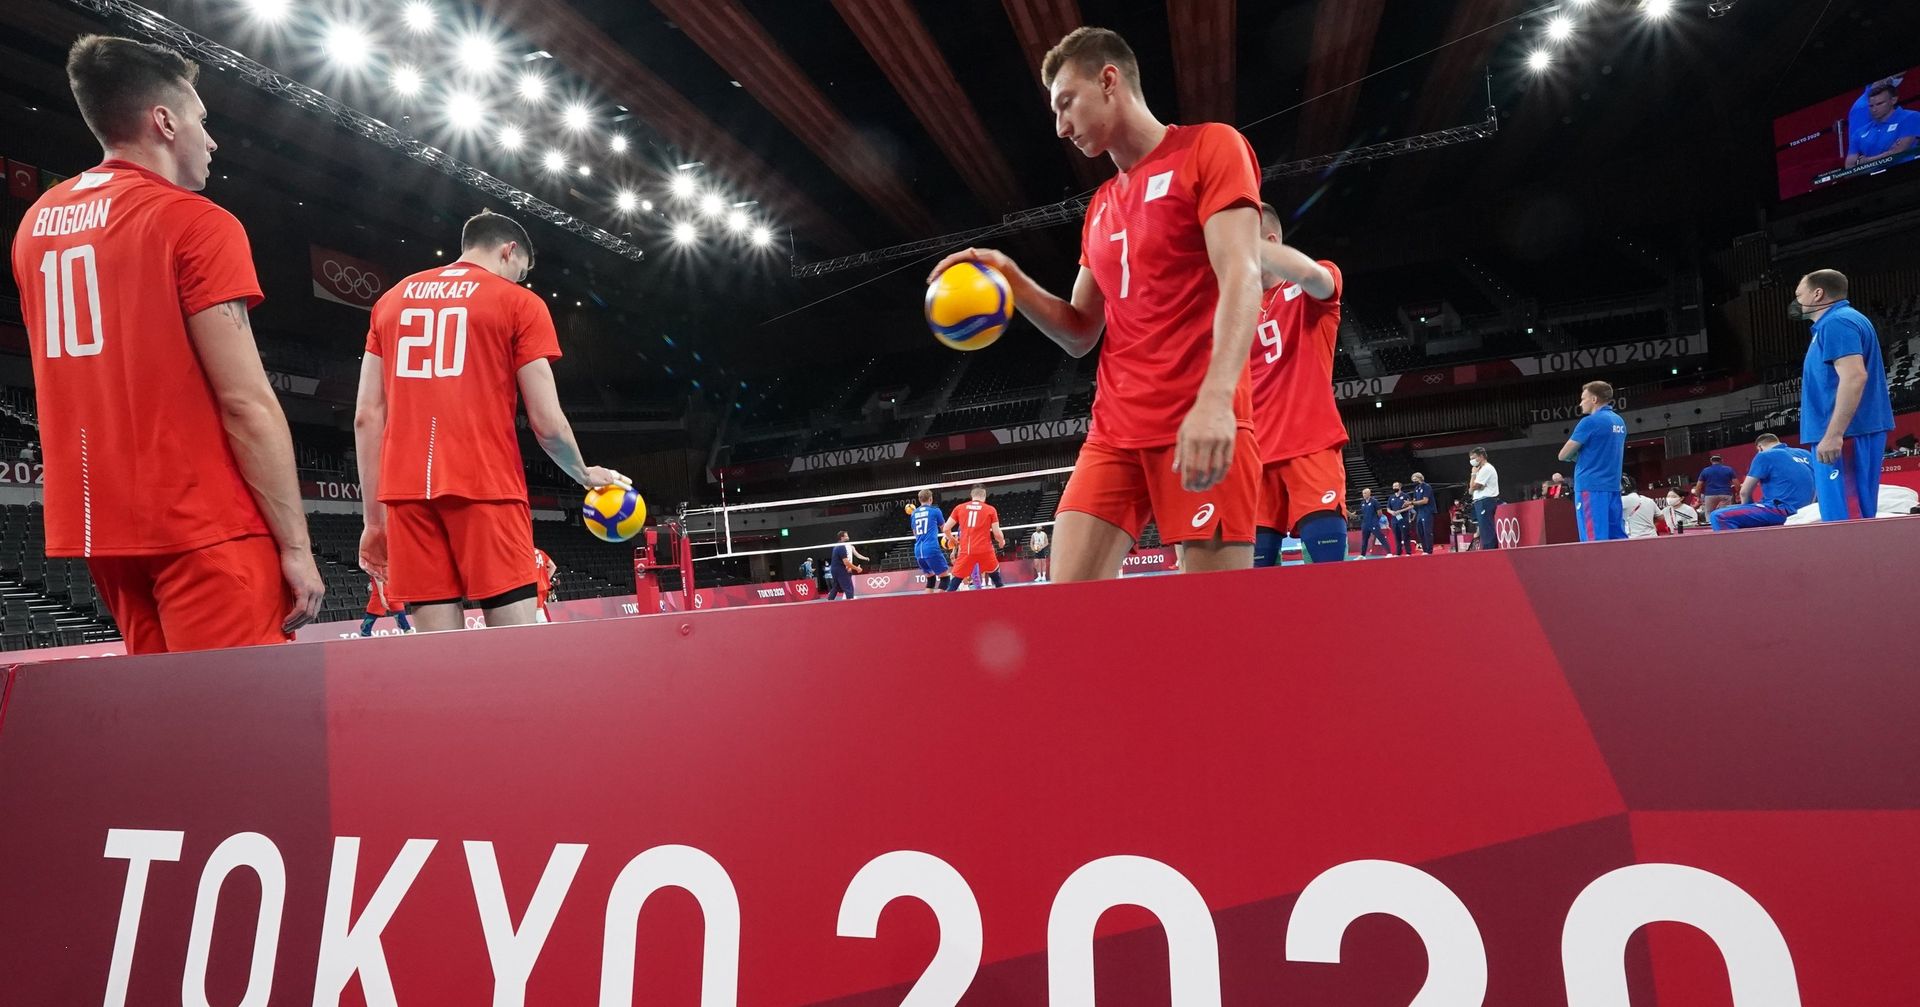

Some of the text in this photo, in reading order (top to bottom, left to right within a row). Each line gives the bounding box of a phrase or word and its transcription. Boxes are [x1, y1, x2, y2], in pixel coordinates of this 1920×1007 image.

[32, 198, 112, 237] BOGDAN
[1109, 228, 1131, 299] 7
[40, 244, 104, 358] 10
[402, 281, 480, 299] KURKAEV
[396, 306, 468, 379] 20
[1257, 319, 1282, 364] 9
[1534, 337, 1690, 374] TOKYO 2020
[1007, 420, 1068, 443] TOKYO
[1612, 425, 1625, 434] ROC
[800, 444, 897, 471] TOKYO 2020
[1885, 464, 1902, 472] 2020
[0, 461, 44, 484] 202
[316, 481, 362, 499] TOKY
[915, 517, 929, 535] 27
[967, 510, 978, 527] 11
[1122, 554, 1164, 566] KYO 2020
[757, 587, 785, 598] TOKYO 2020
[621, 602, 639, 614] TOK
[103, 828, 742, 1007] TOKYO
